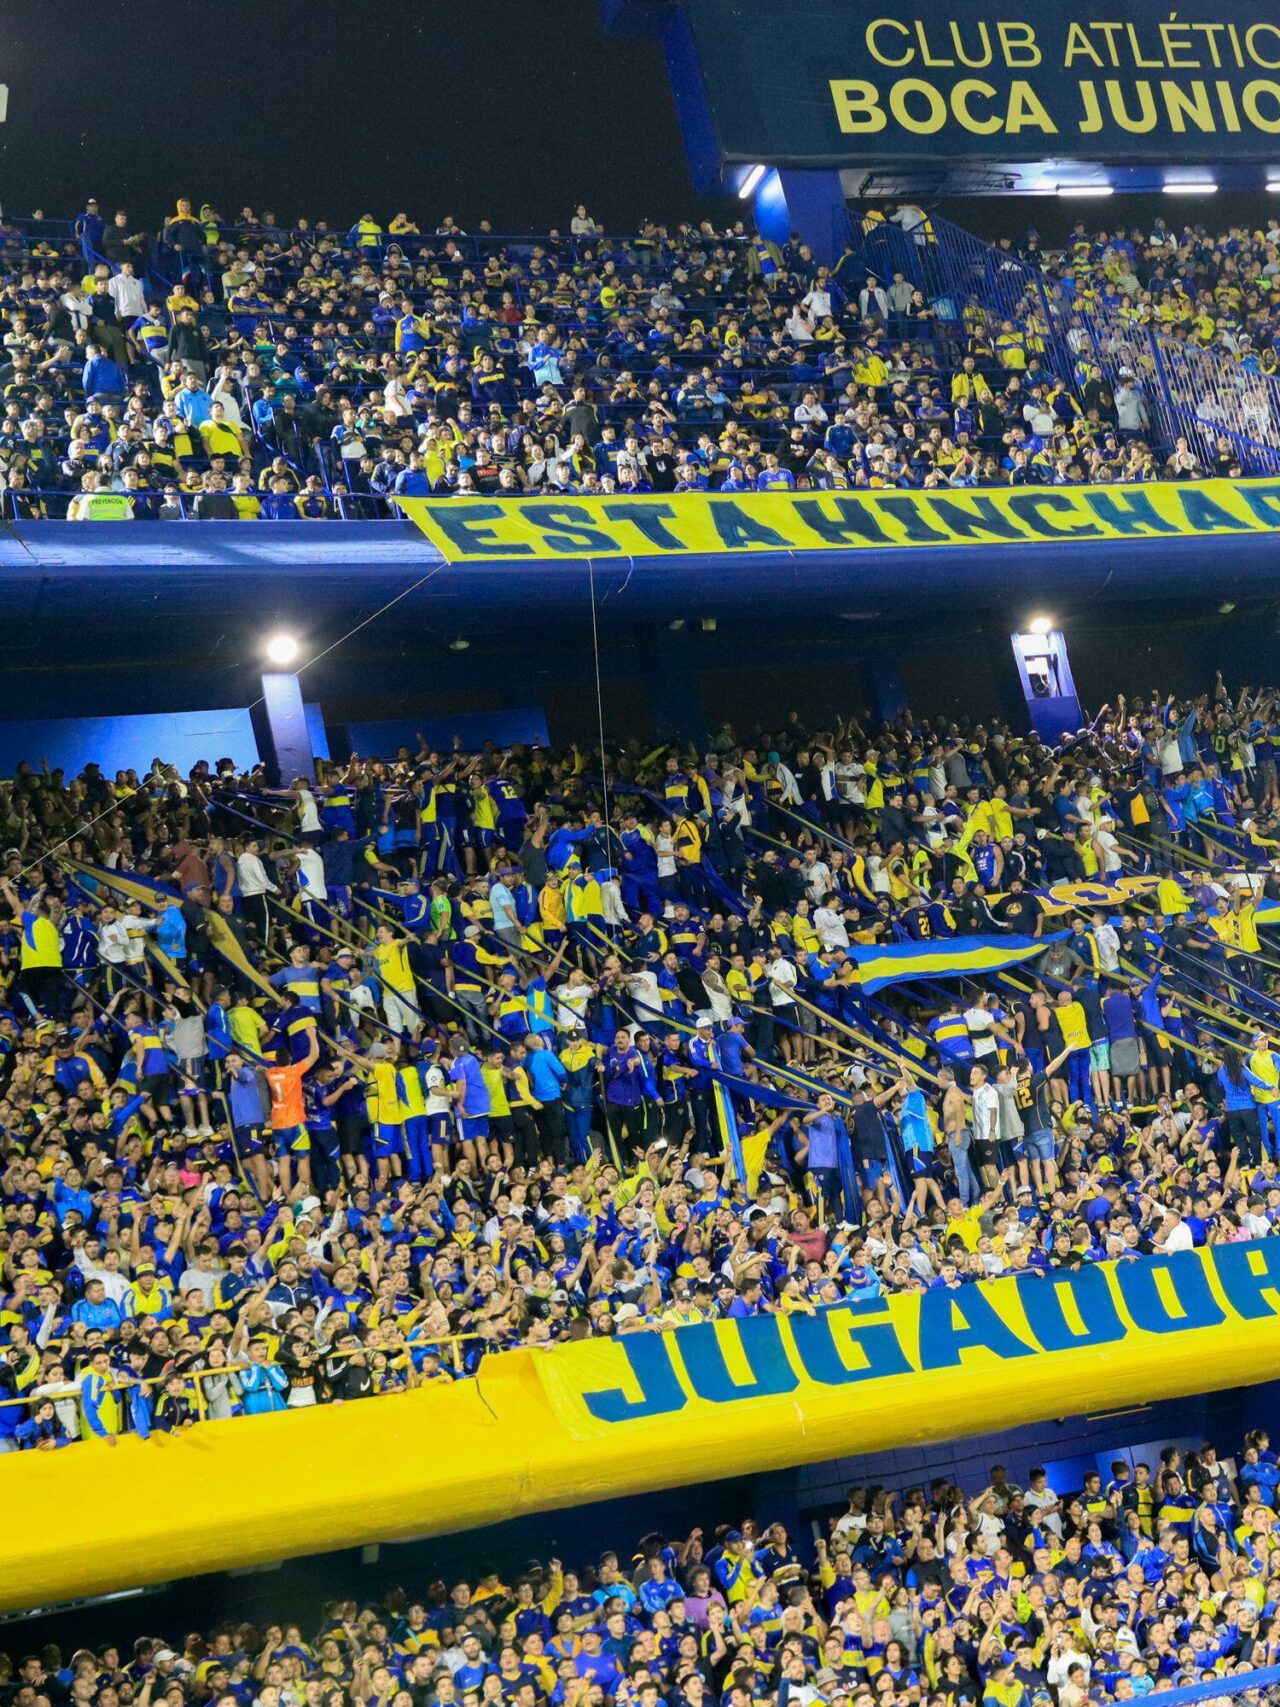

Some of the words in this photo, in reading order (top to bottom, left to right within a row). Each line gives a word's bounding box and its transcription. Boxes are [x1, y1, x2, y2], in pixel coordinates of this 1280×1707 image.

[865, 18, 1042, 69] CLUB
[828, 78, 1059, 135] BOCA
[425, 497, 796, 556] ESTA
[501, 785, 518, 800] 12
[274, 1081, 284, 1103] 1
[1012, 1086, 1034, 1110] 12
